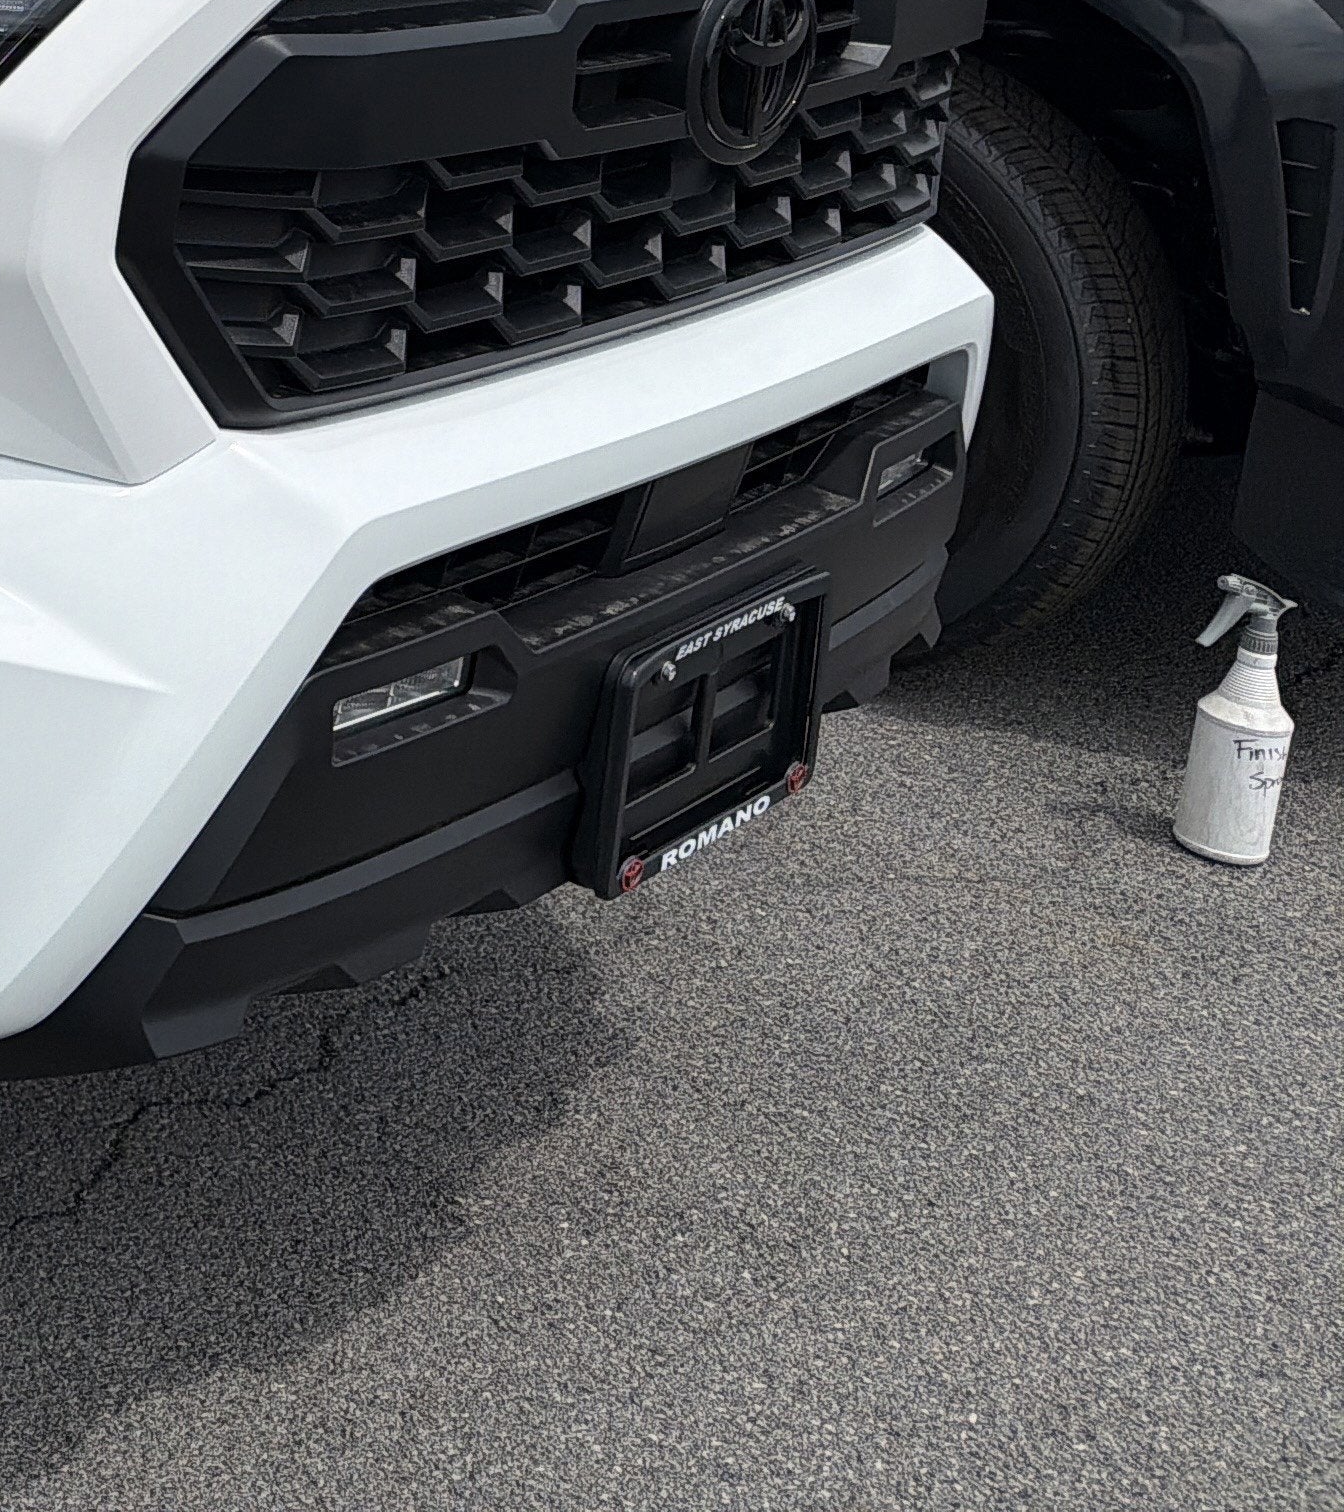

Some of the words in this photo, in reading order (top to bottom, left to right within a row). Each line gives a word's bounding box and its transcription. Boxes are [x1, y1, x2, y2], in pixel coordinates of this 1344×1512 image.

[674, 630, 713, 662] EAST
[712, 595, 786, 643] SYRACUSE
[660, 795, 771, 872] ROMANO
